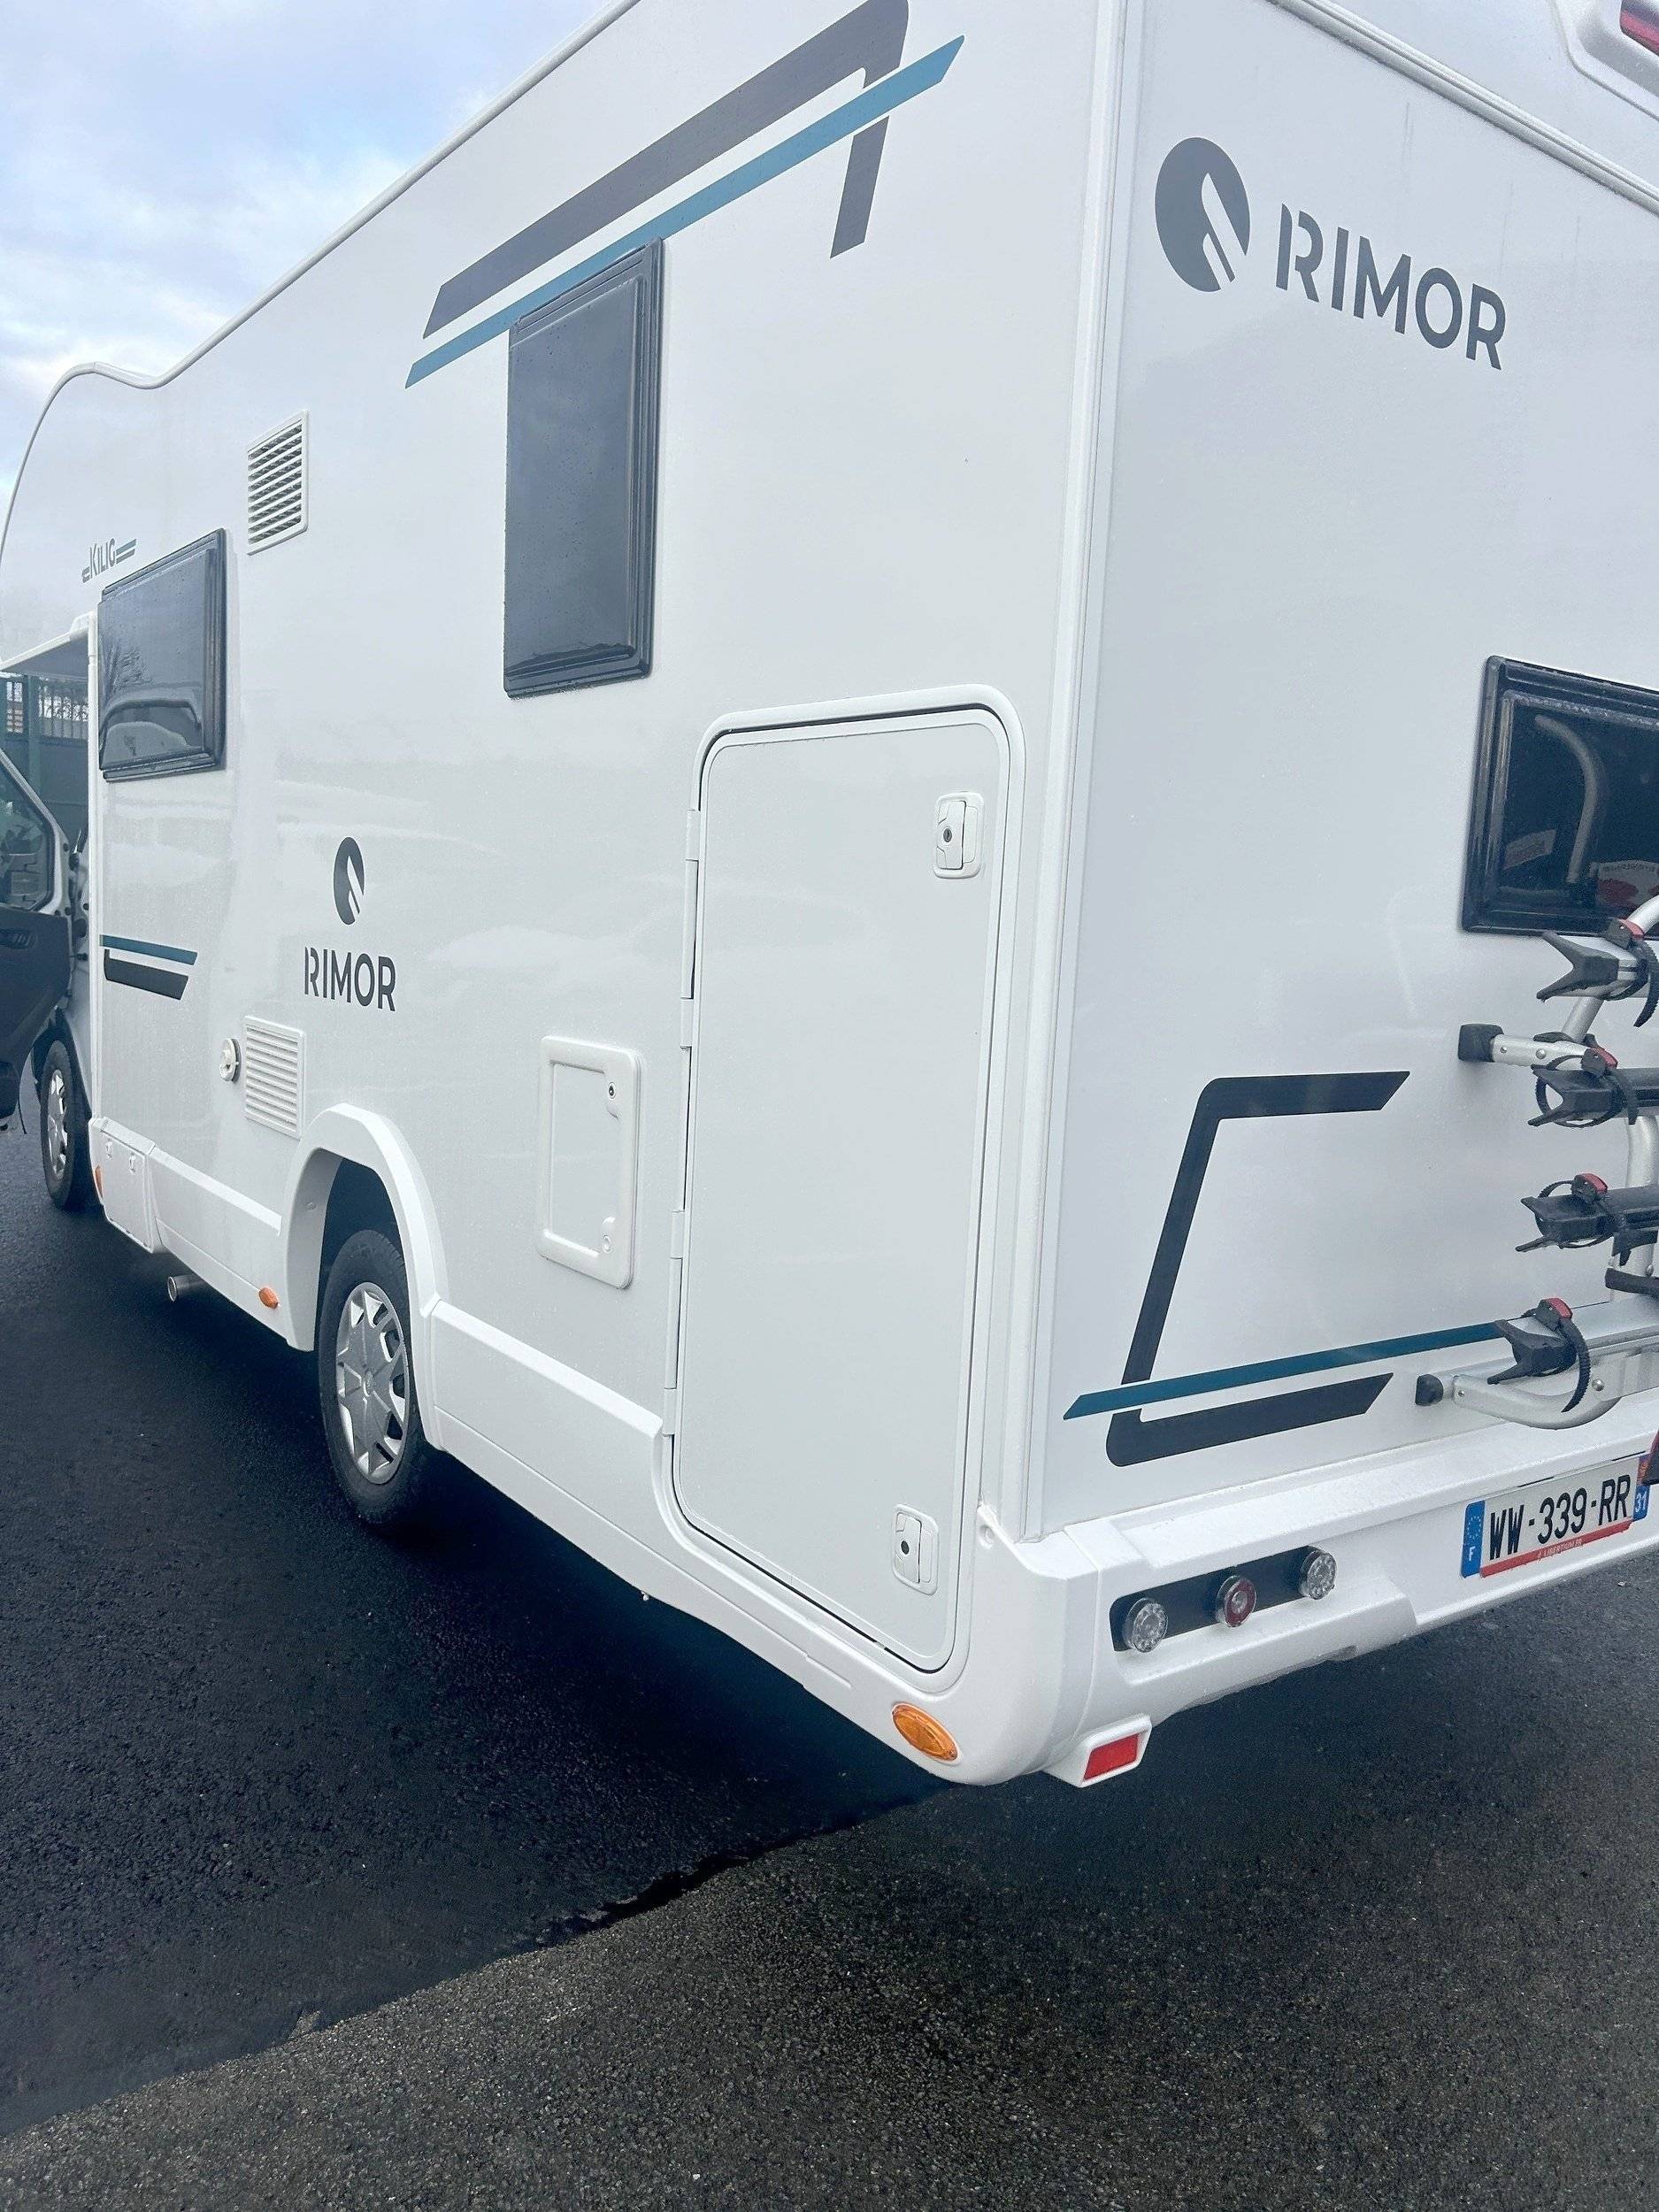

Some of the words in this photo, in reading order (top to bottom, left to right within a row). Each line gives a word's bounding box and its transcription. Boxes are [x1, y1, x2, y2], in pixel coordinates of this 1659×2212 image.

[1275, 203, 1506, 371] RIMOR
[89, 537, 116, 580] KILIG
[303, 946, 396, 1012] RIMOR
[1489, 1473, 1632, 1561] WW-339-RR
[1634, 1490, 1647, 1513] 31
[1467, 1545, 1476, 1562] F
